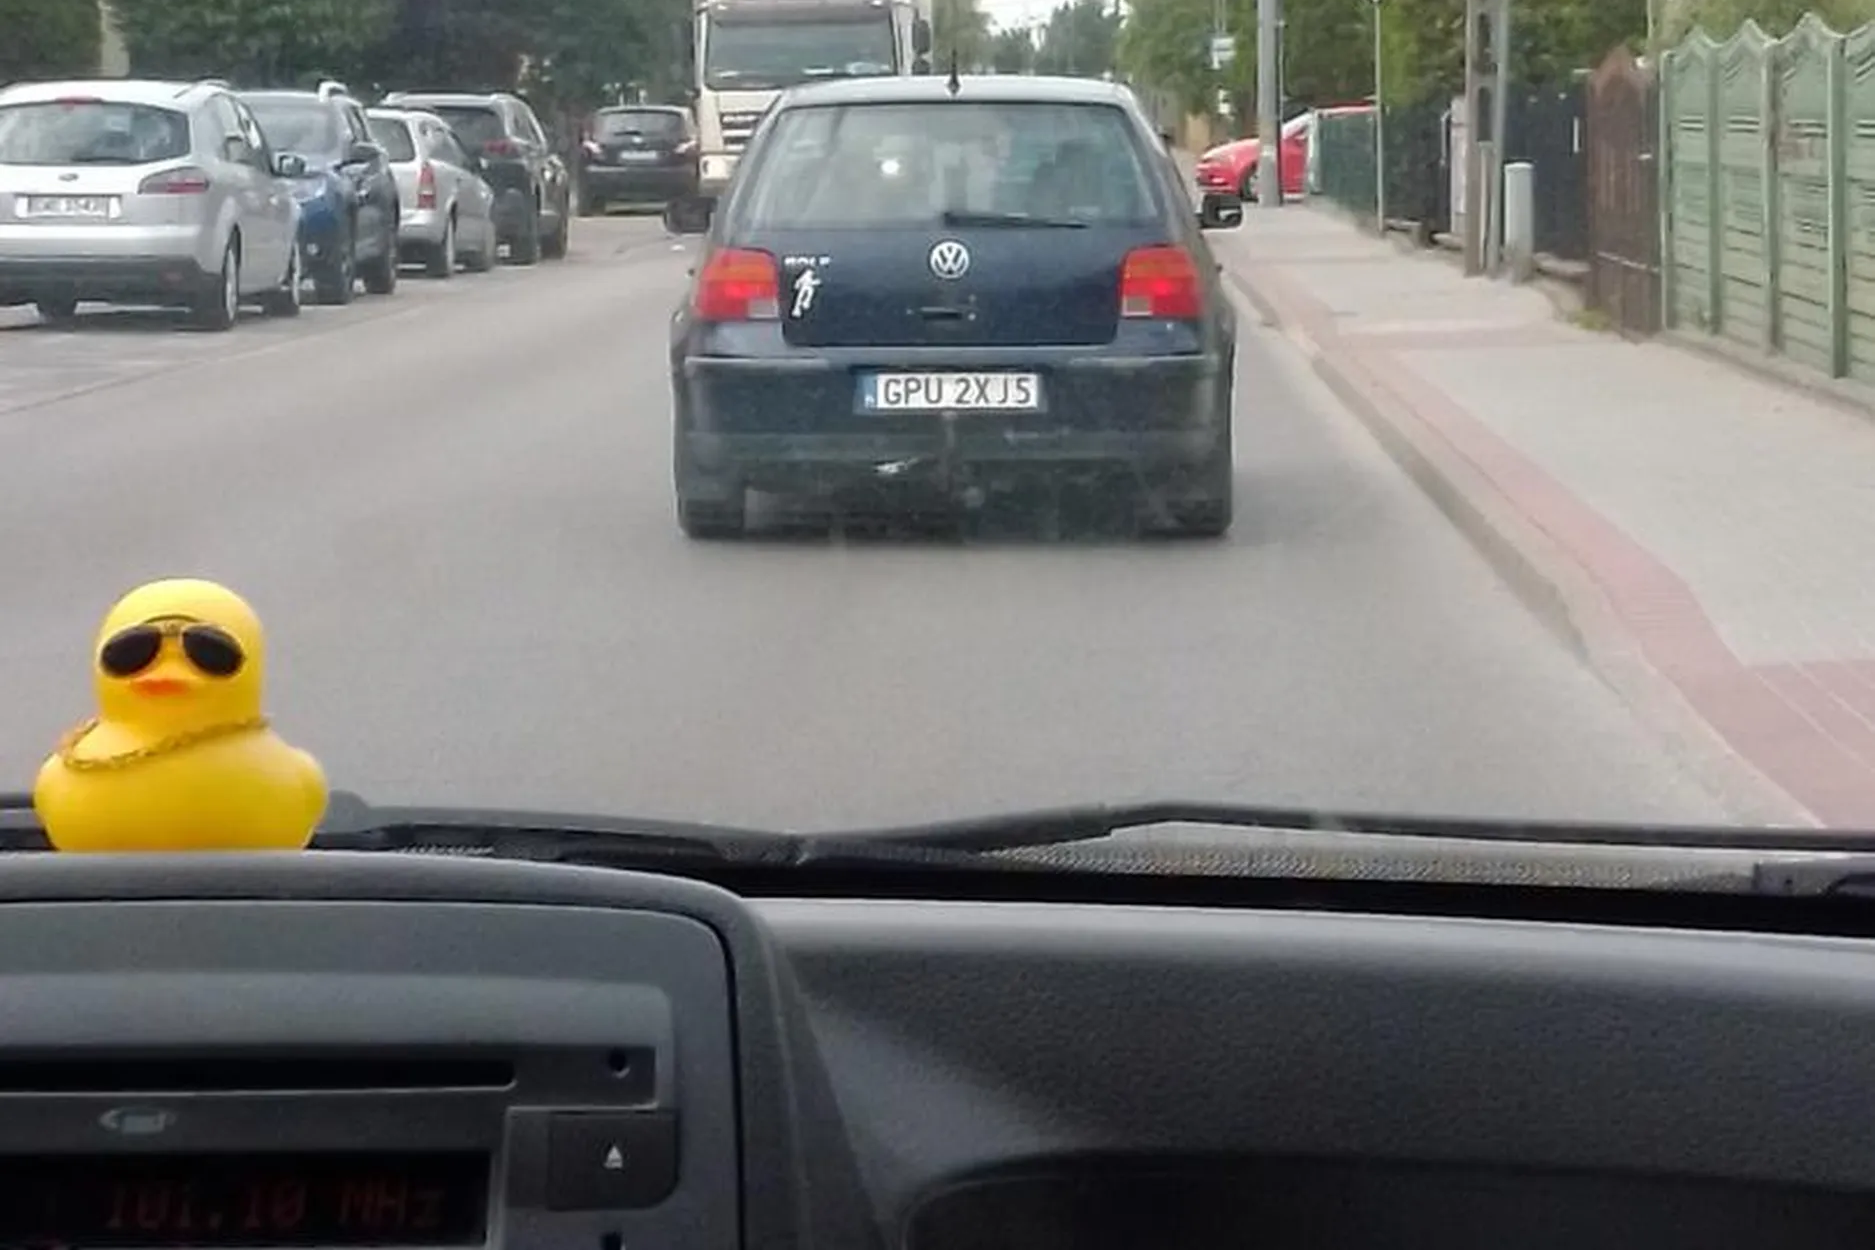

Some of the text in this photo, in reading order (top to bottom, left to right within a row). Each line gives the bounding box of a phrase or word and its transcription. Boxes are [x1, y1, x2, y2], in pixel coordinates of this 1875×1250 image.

[883, 376, 943, 405] GPU
[954, 376, 1032, 405] 2XJ5
[338, 1176, 446, 1229] MHz
